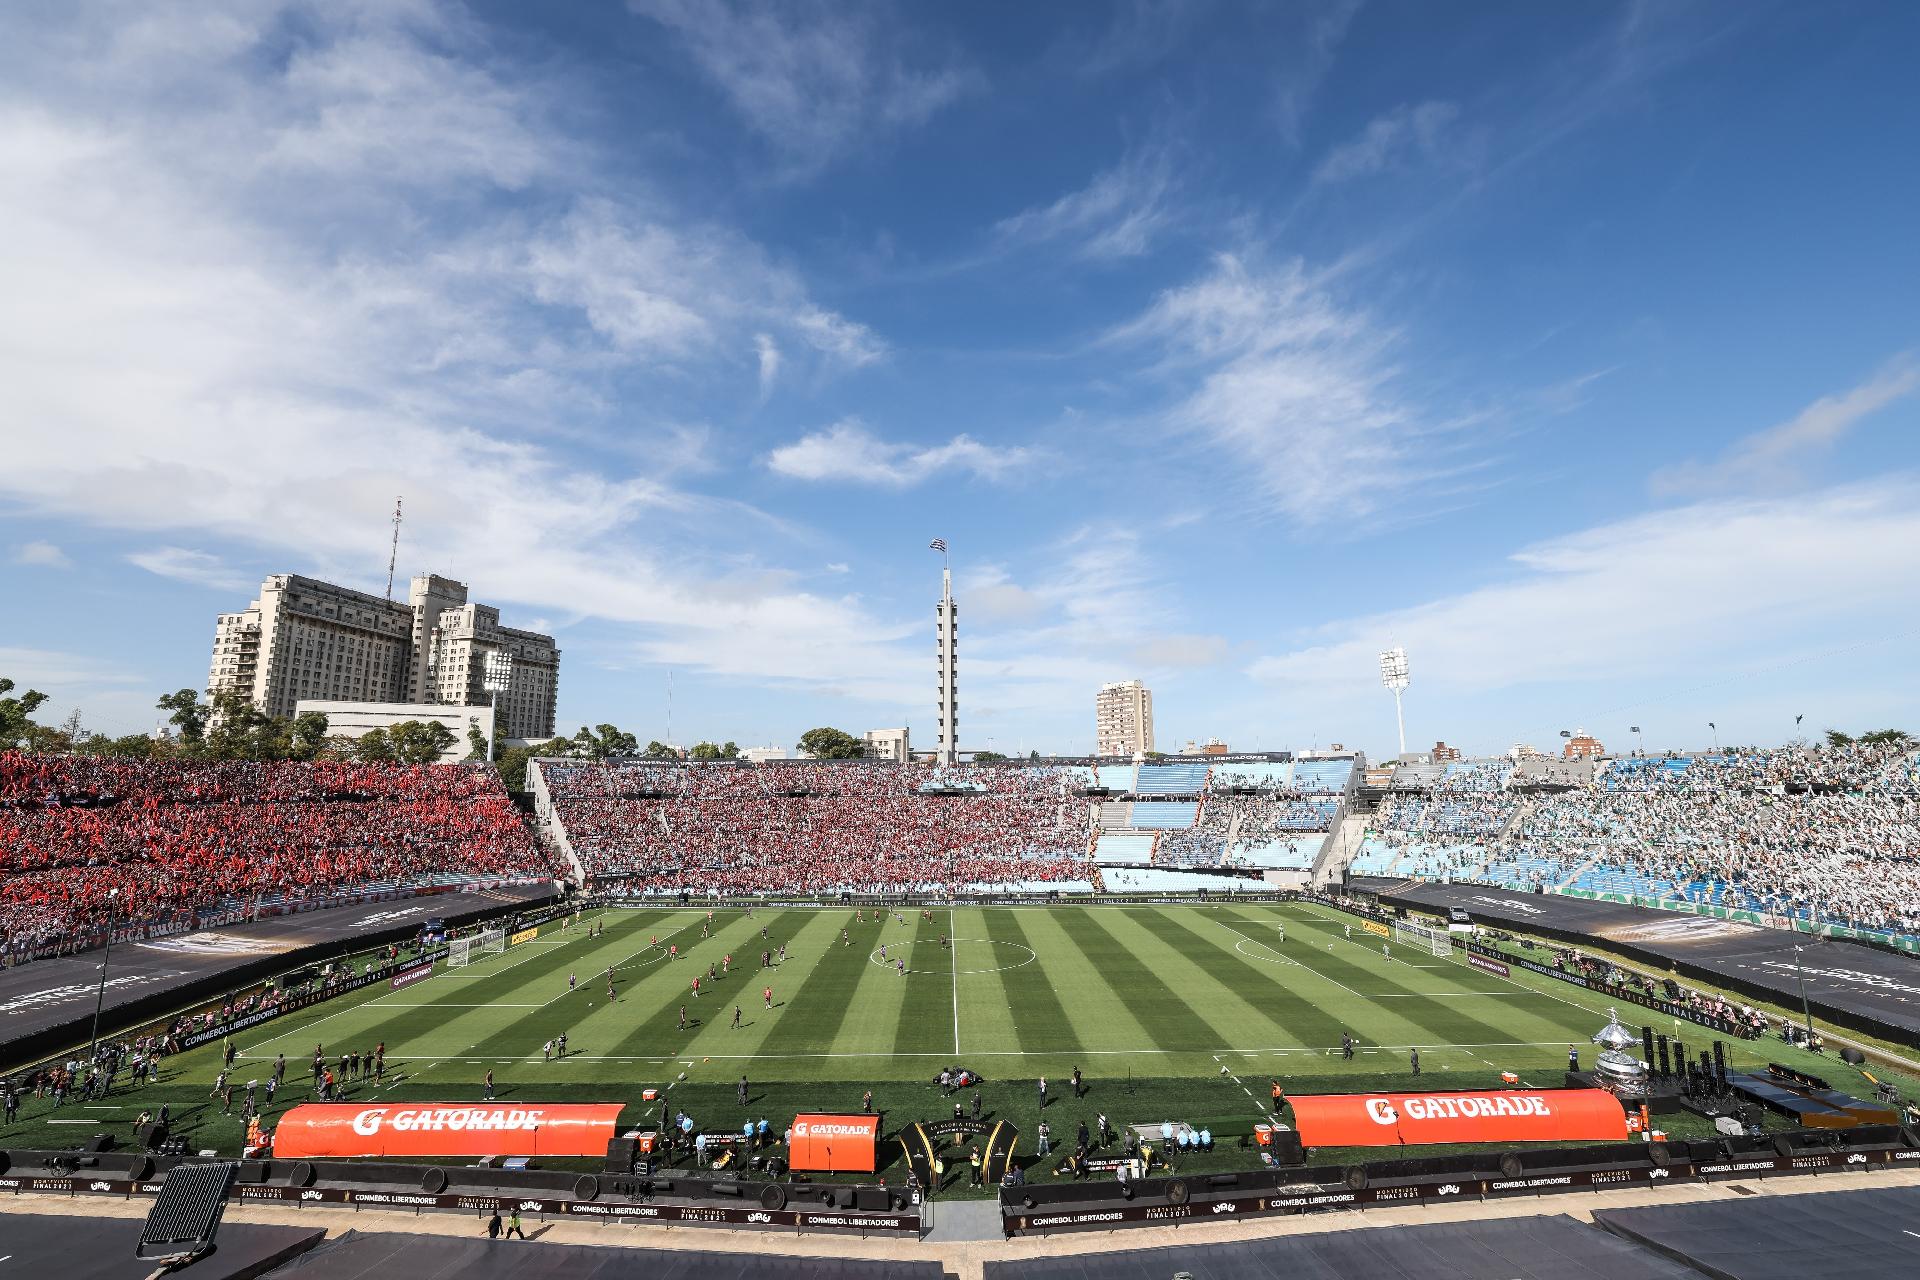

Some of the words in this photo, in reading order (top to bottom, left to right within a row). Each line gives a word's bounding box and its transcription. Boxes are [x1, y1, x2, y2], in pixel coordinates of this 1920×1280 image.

[1520, 960, 1547, 974] CONMEBOL
[1547, 969, 1587, 987] LIBERTADORES
[281, 985, 344, 1013] MONTEVIDEO
[346, 977, 366, 990] FINAL
[1589, 981, 1661, 1009] MONTEVIDEO
[1662, 1003, 1693, 1020] FINAL
[1695, 1014, 1729, 1032] 2021
[184, 1025, 229, 1047] CONMEBOL
[229, 1007, 279, 1030] LIBERTADORES
[1365, 1098, 1399, 1125] G
[1404, 1096, 1551, 1120] GATORADE
[352, 1109, 390, 1136] G
[392, 1108, 546, 1131] GATORADE
[795, 1123, 808, 1136] G
[810, 1124, 871, 1135] GATORADE
[1700, 1164, 1733, 1173] CONMEBOL
[1732, 1161, 1775, 1171] LIBERTADORES
[1492, 1180, 1528, 1190] CONMEBOL
[1527, 1176, 1572, 1187] LIBERTADORES
[1592, 1176, 1611, 1184] FINAL
[355, 1194, 391, 1203] CONMEBOL
[391, 1195, 437, 1205] LIBERTADORES
[1270, 1199, 1308, 1208] CONMEBOL
[1309, 1194, 1355, 1205] LIBERTADORES
[572, 1205, 610, 1214] CONMEBOL
[610, 1207, 658, 1216] LIBERTADORES
[808, 1216, 848, 1225] CONMEBOL
[849, 1217, 900, 1228] LIBERTADORES
[1032, 1216, 1073, 1226] CONMEBOL
[1073, 1212, 1123, 1223] LIBERTADORES
